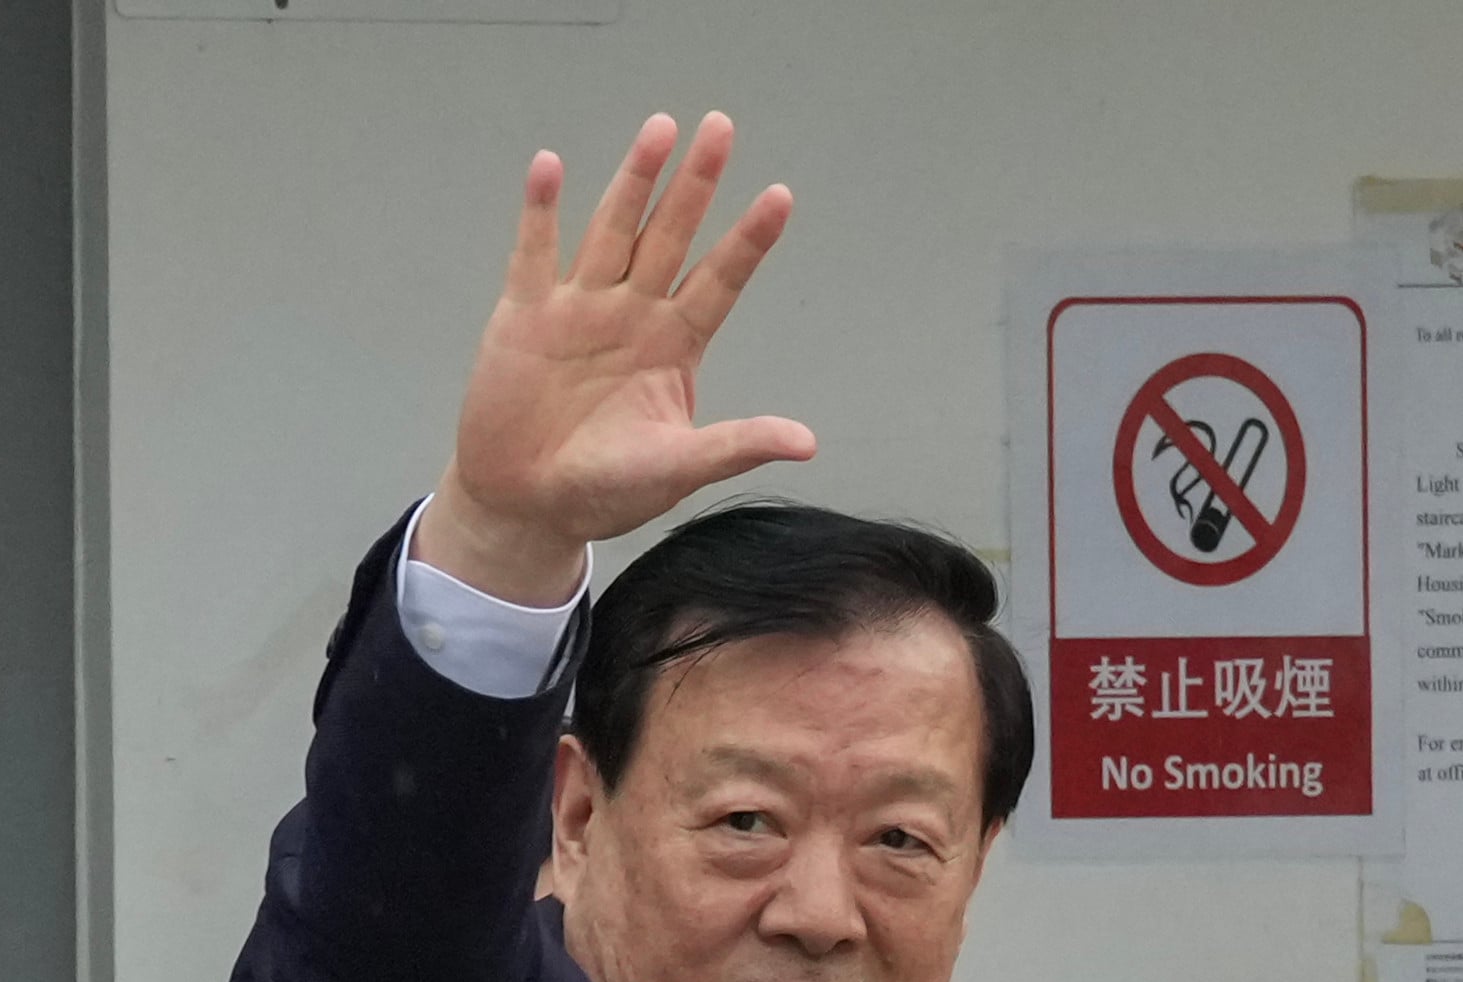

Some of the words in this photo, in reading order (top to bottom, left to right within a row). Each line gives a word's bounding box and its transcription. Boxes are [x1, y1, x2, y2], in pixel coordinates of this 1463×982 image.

[1416, 473, 1460, 497] Light
[1417, 608, 1463, 626] "Smo
[1088, 655, 1335, 721] 禁止吸煙
[1417, 734, 1445, 752] For
[1101, 756, 1153, 790] No
[1164, 752, 1324, 798] Smoking
[1418, 767, 1433, 782] at
